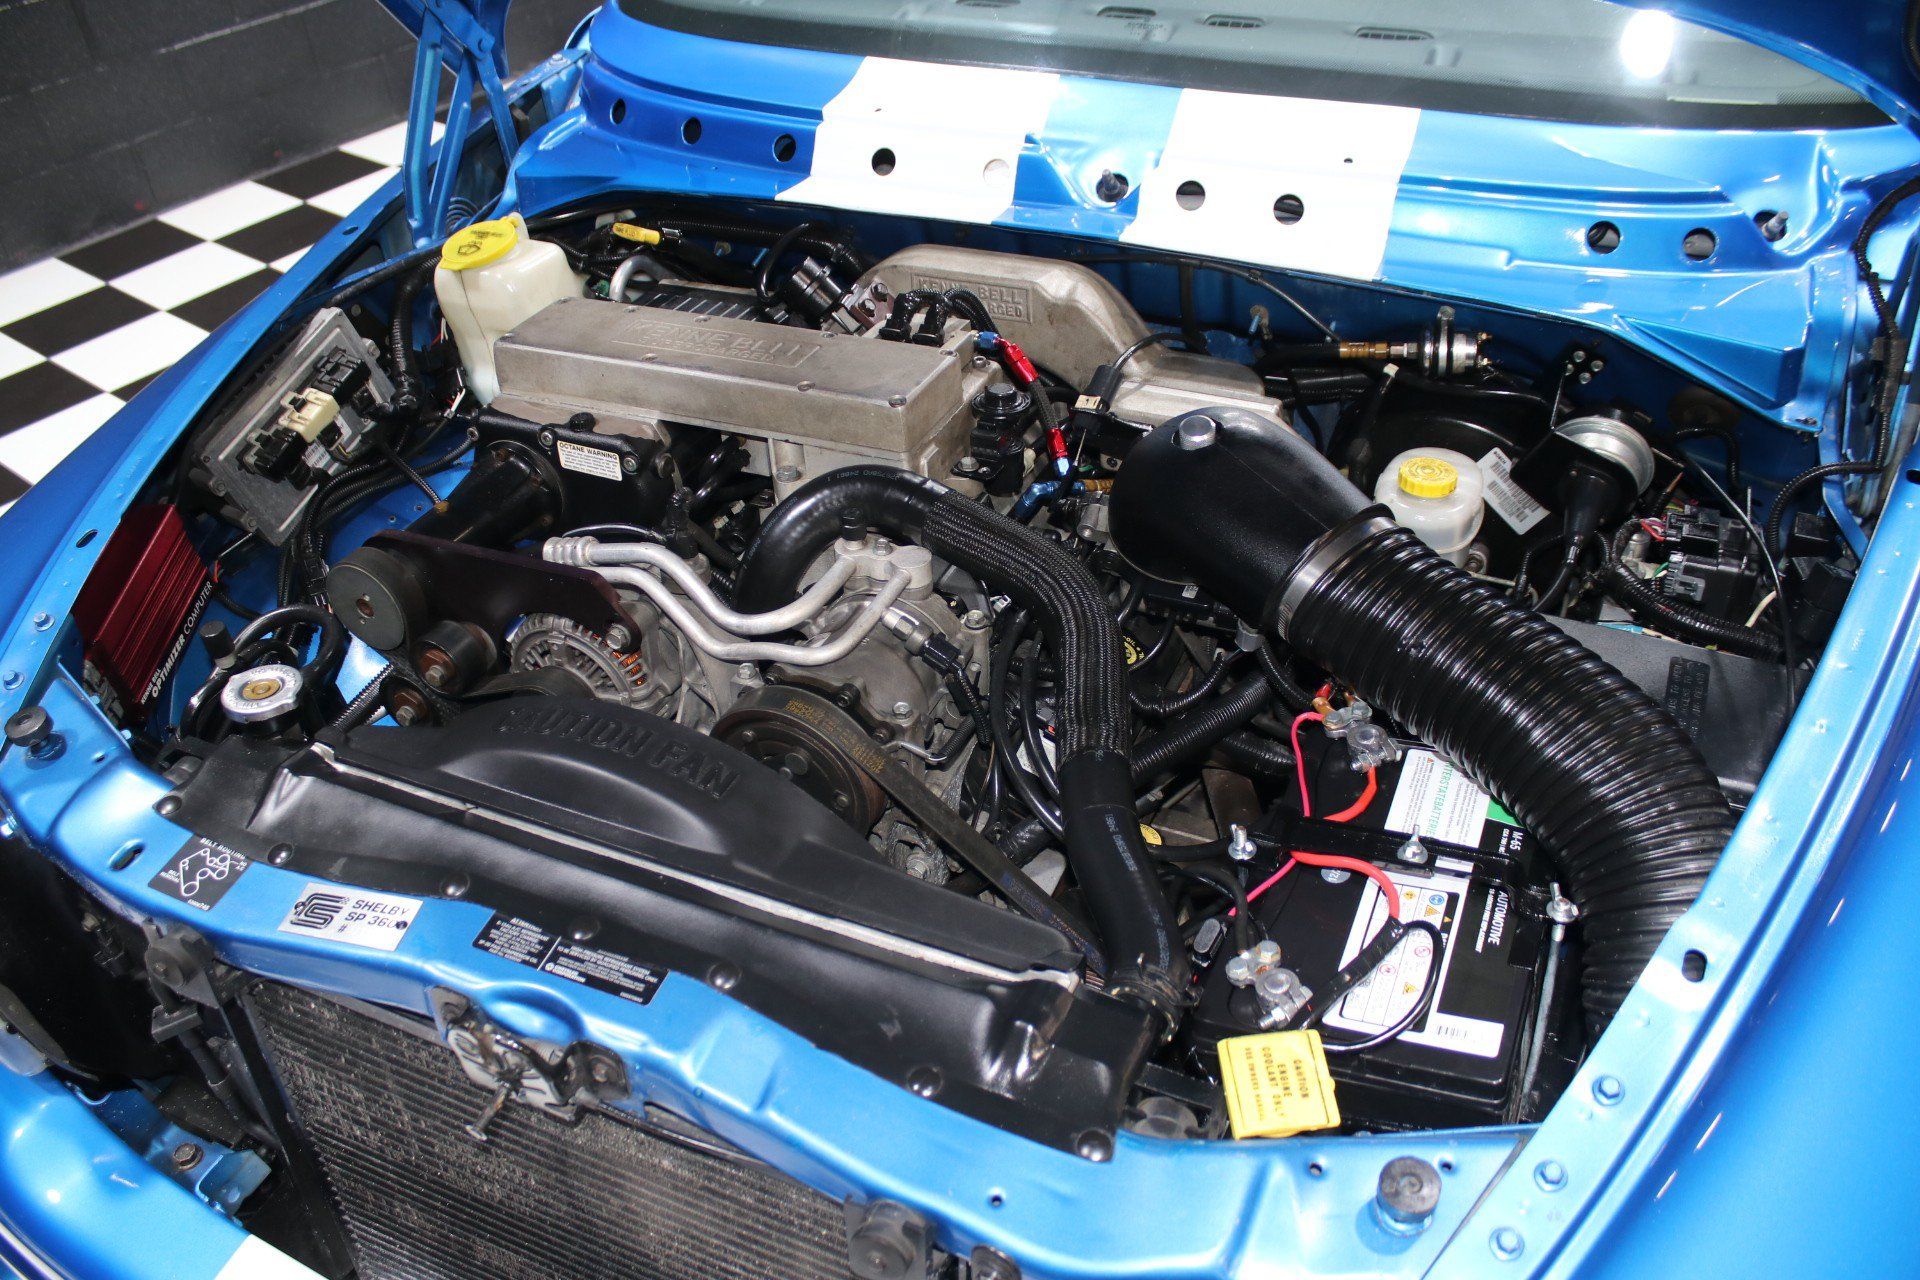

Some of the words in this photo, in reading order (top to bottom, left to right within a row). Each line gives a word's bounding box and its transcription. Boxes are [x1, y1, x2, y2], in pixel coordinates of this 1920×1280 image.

[977, 285, 1022, 303] BELL
[559, 442, 585, 452] OCTANE
[587, 449, 618, 460] WARNING
[152, 634, 186, 697] OPTIMIZER
[184, 581, 214, 634] COMPUTER
[141, 681, 154, 704] KENNE
[152, 669, 162, 683] BELL
[650, 740, 740, 799] FAN
[200, 838, 219, 850] BELT
[1509, 830, 1523, 850] M-65
[345, 911, 366, 922] SP
[352, 899, 410, 915] SHELBY
[1487, 890, 1510, 945] AUTOMOTIVE
[1261, 1045, 1278, 1088] COOLANT
[1277, 1063, 1292, 1098] ENGINE
[1293, 1058, 1309, 1099] CAUTION
